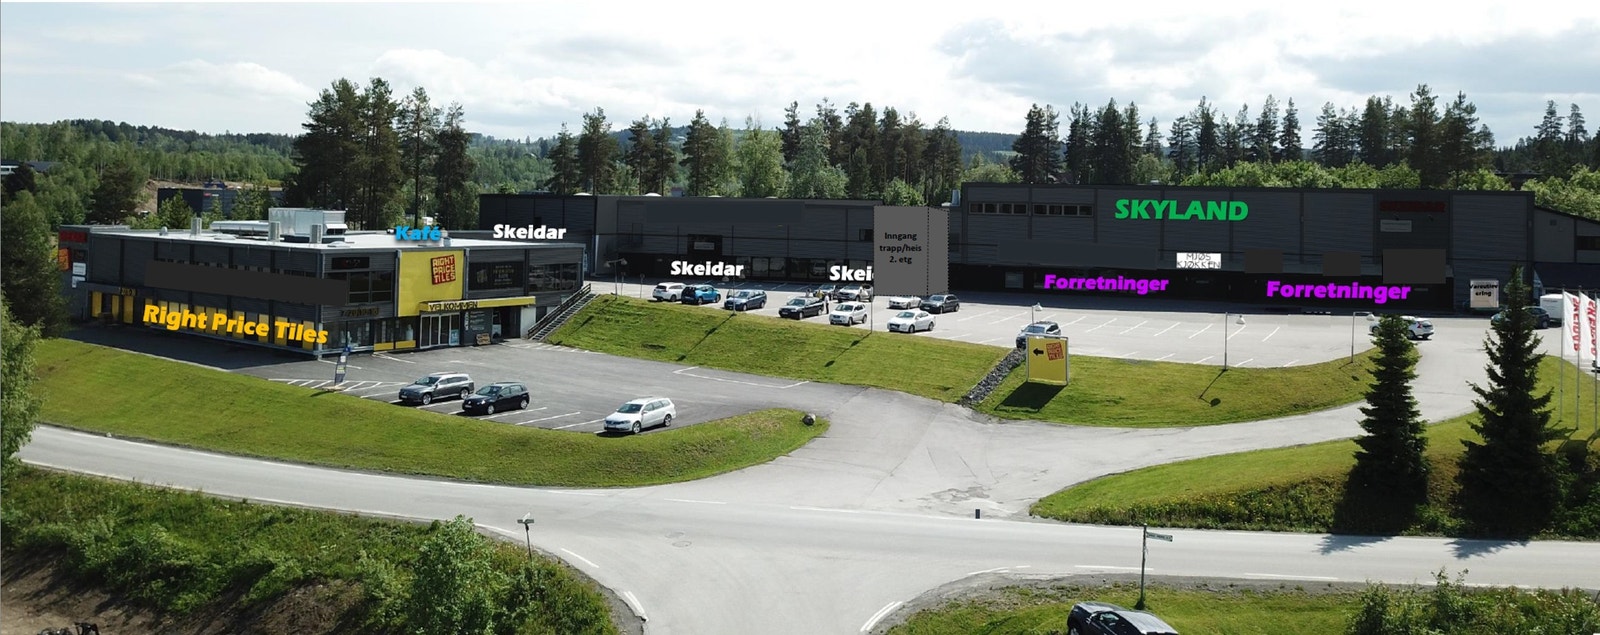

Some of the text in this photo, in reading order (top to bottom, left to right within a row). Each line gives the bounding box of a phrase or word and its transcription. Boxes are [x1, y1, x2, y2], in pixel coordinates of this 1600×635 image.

[432, 256, 454, 267] RIGHT
[433, 264, 455, 275] PRICE
[434, 272, 456, 284] TILES
